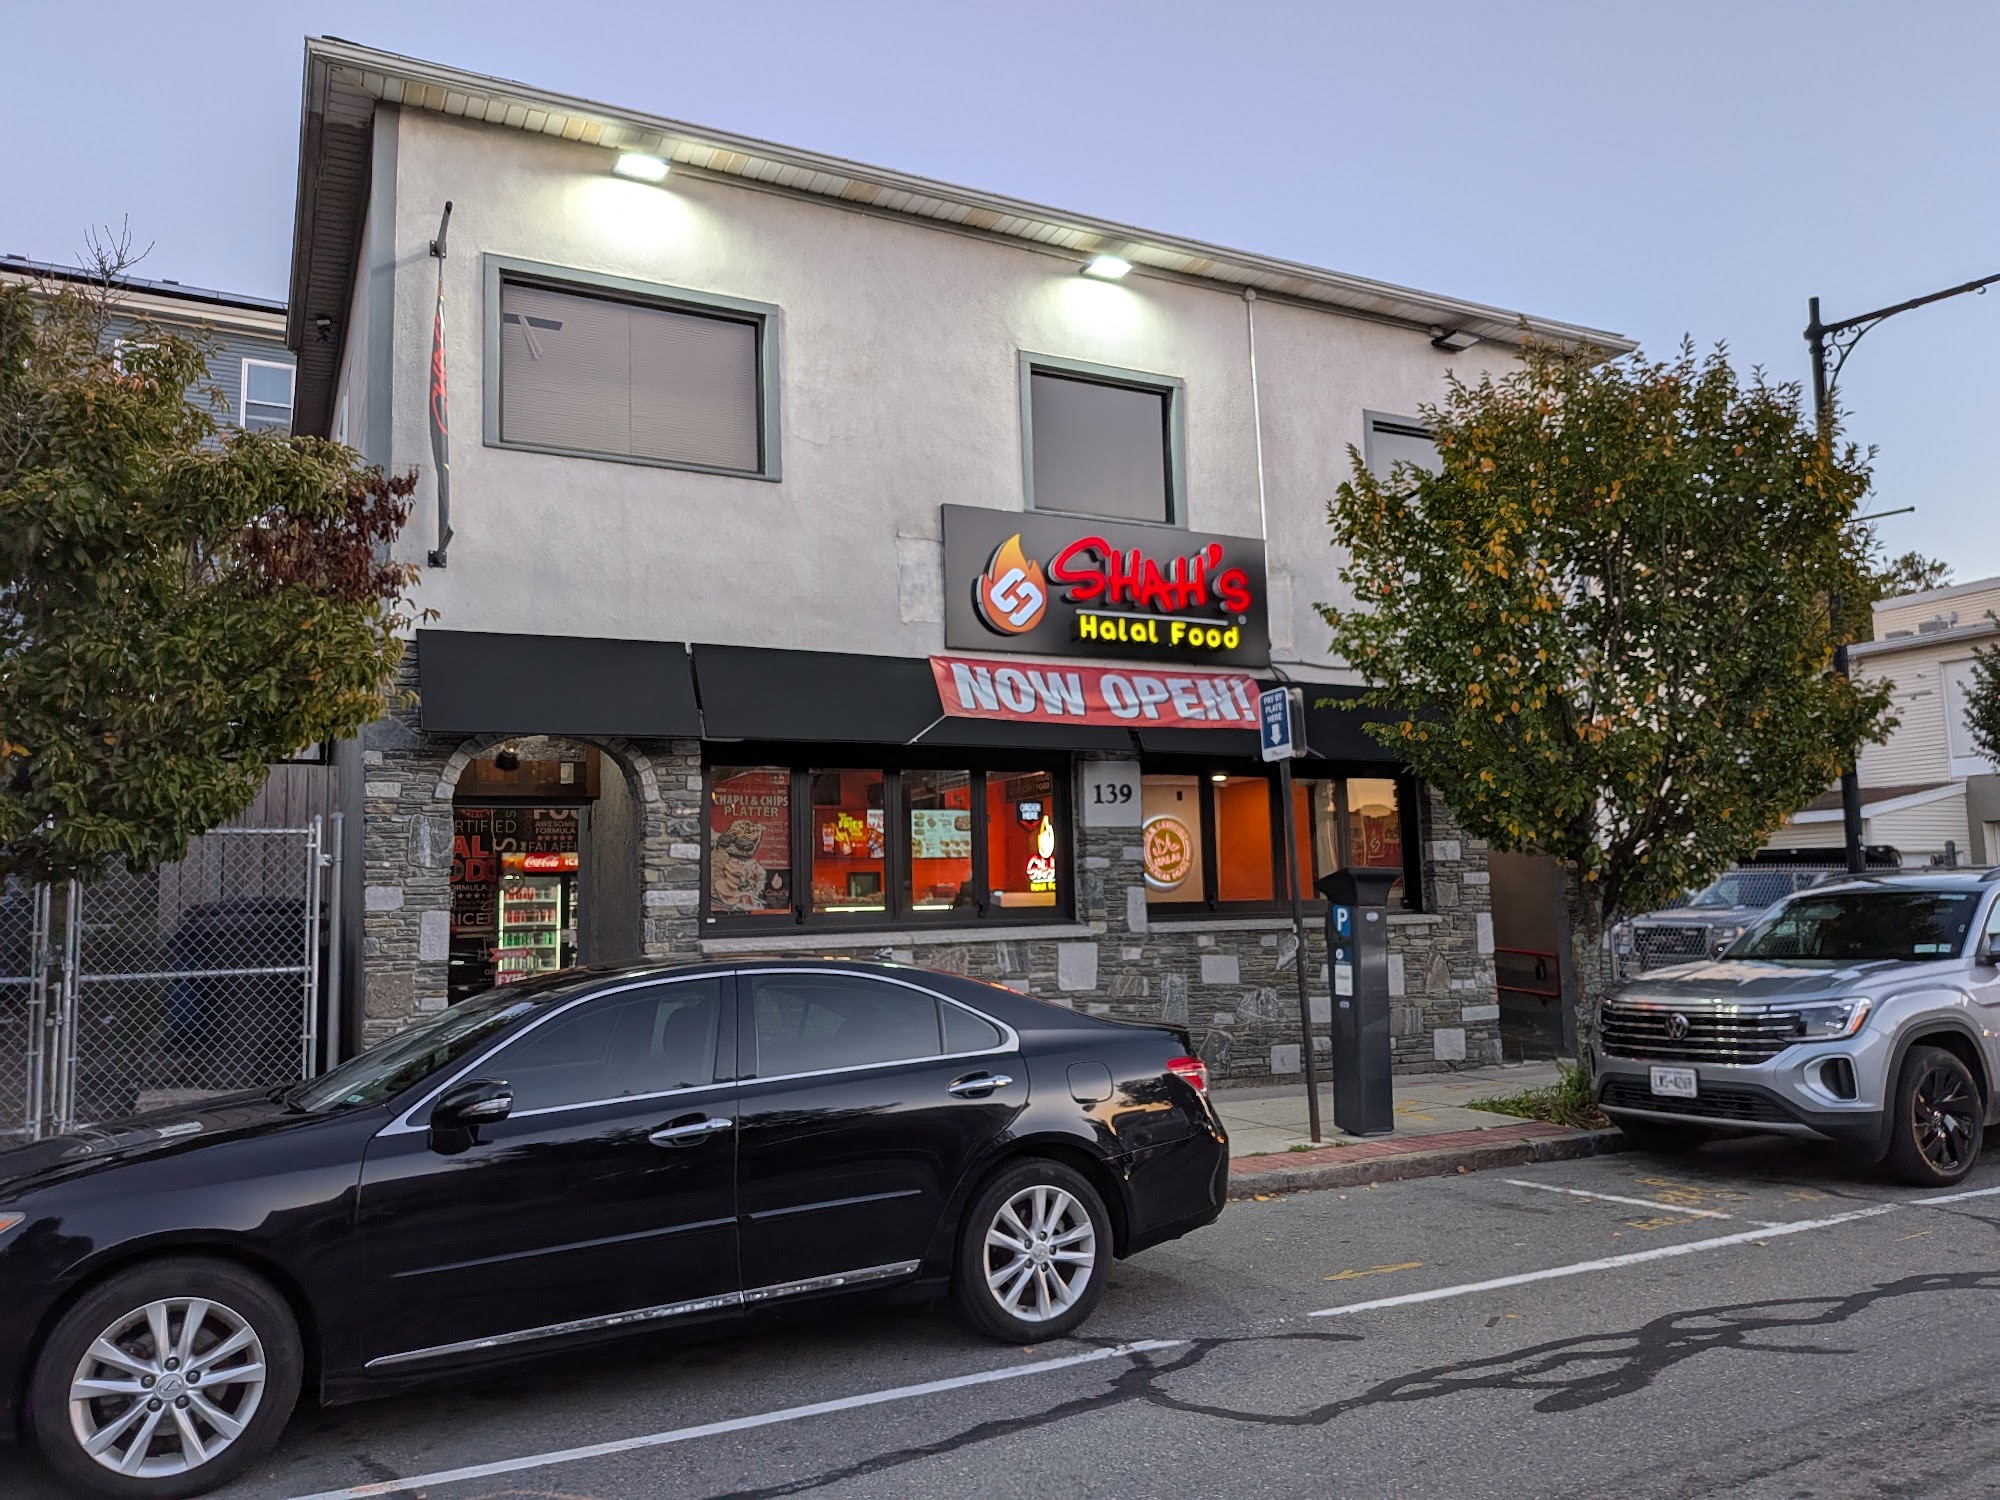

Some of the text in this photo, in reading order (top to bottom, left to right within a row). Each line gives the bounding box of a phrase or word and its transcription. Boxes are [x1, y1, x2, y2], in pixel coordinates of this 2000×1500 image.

[1080, 614, 1240, 650] Halal Food
[949, 662, 1258, 722] NOW OPEN!
[1263, 692, 1283, 705] PAY BY
[1265, 702, 1283, 715] PLATE
[1267, 713, 1283, 723] HERE
[1094, 783, 1132, 805] 139
[750, 796, 758, 806] &
[760, 796, 789, 807] CHIPS
[724, 806, 778, 817] PLATTER
[1337, 908, 1348, 931] P
